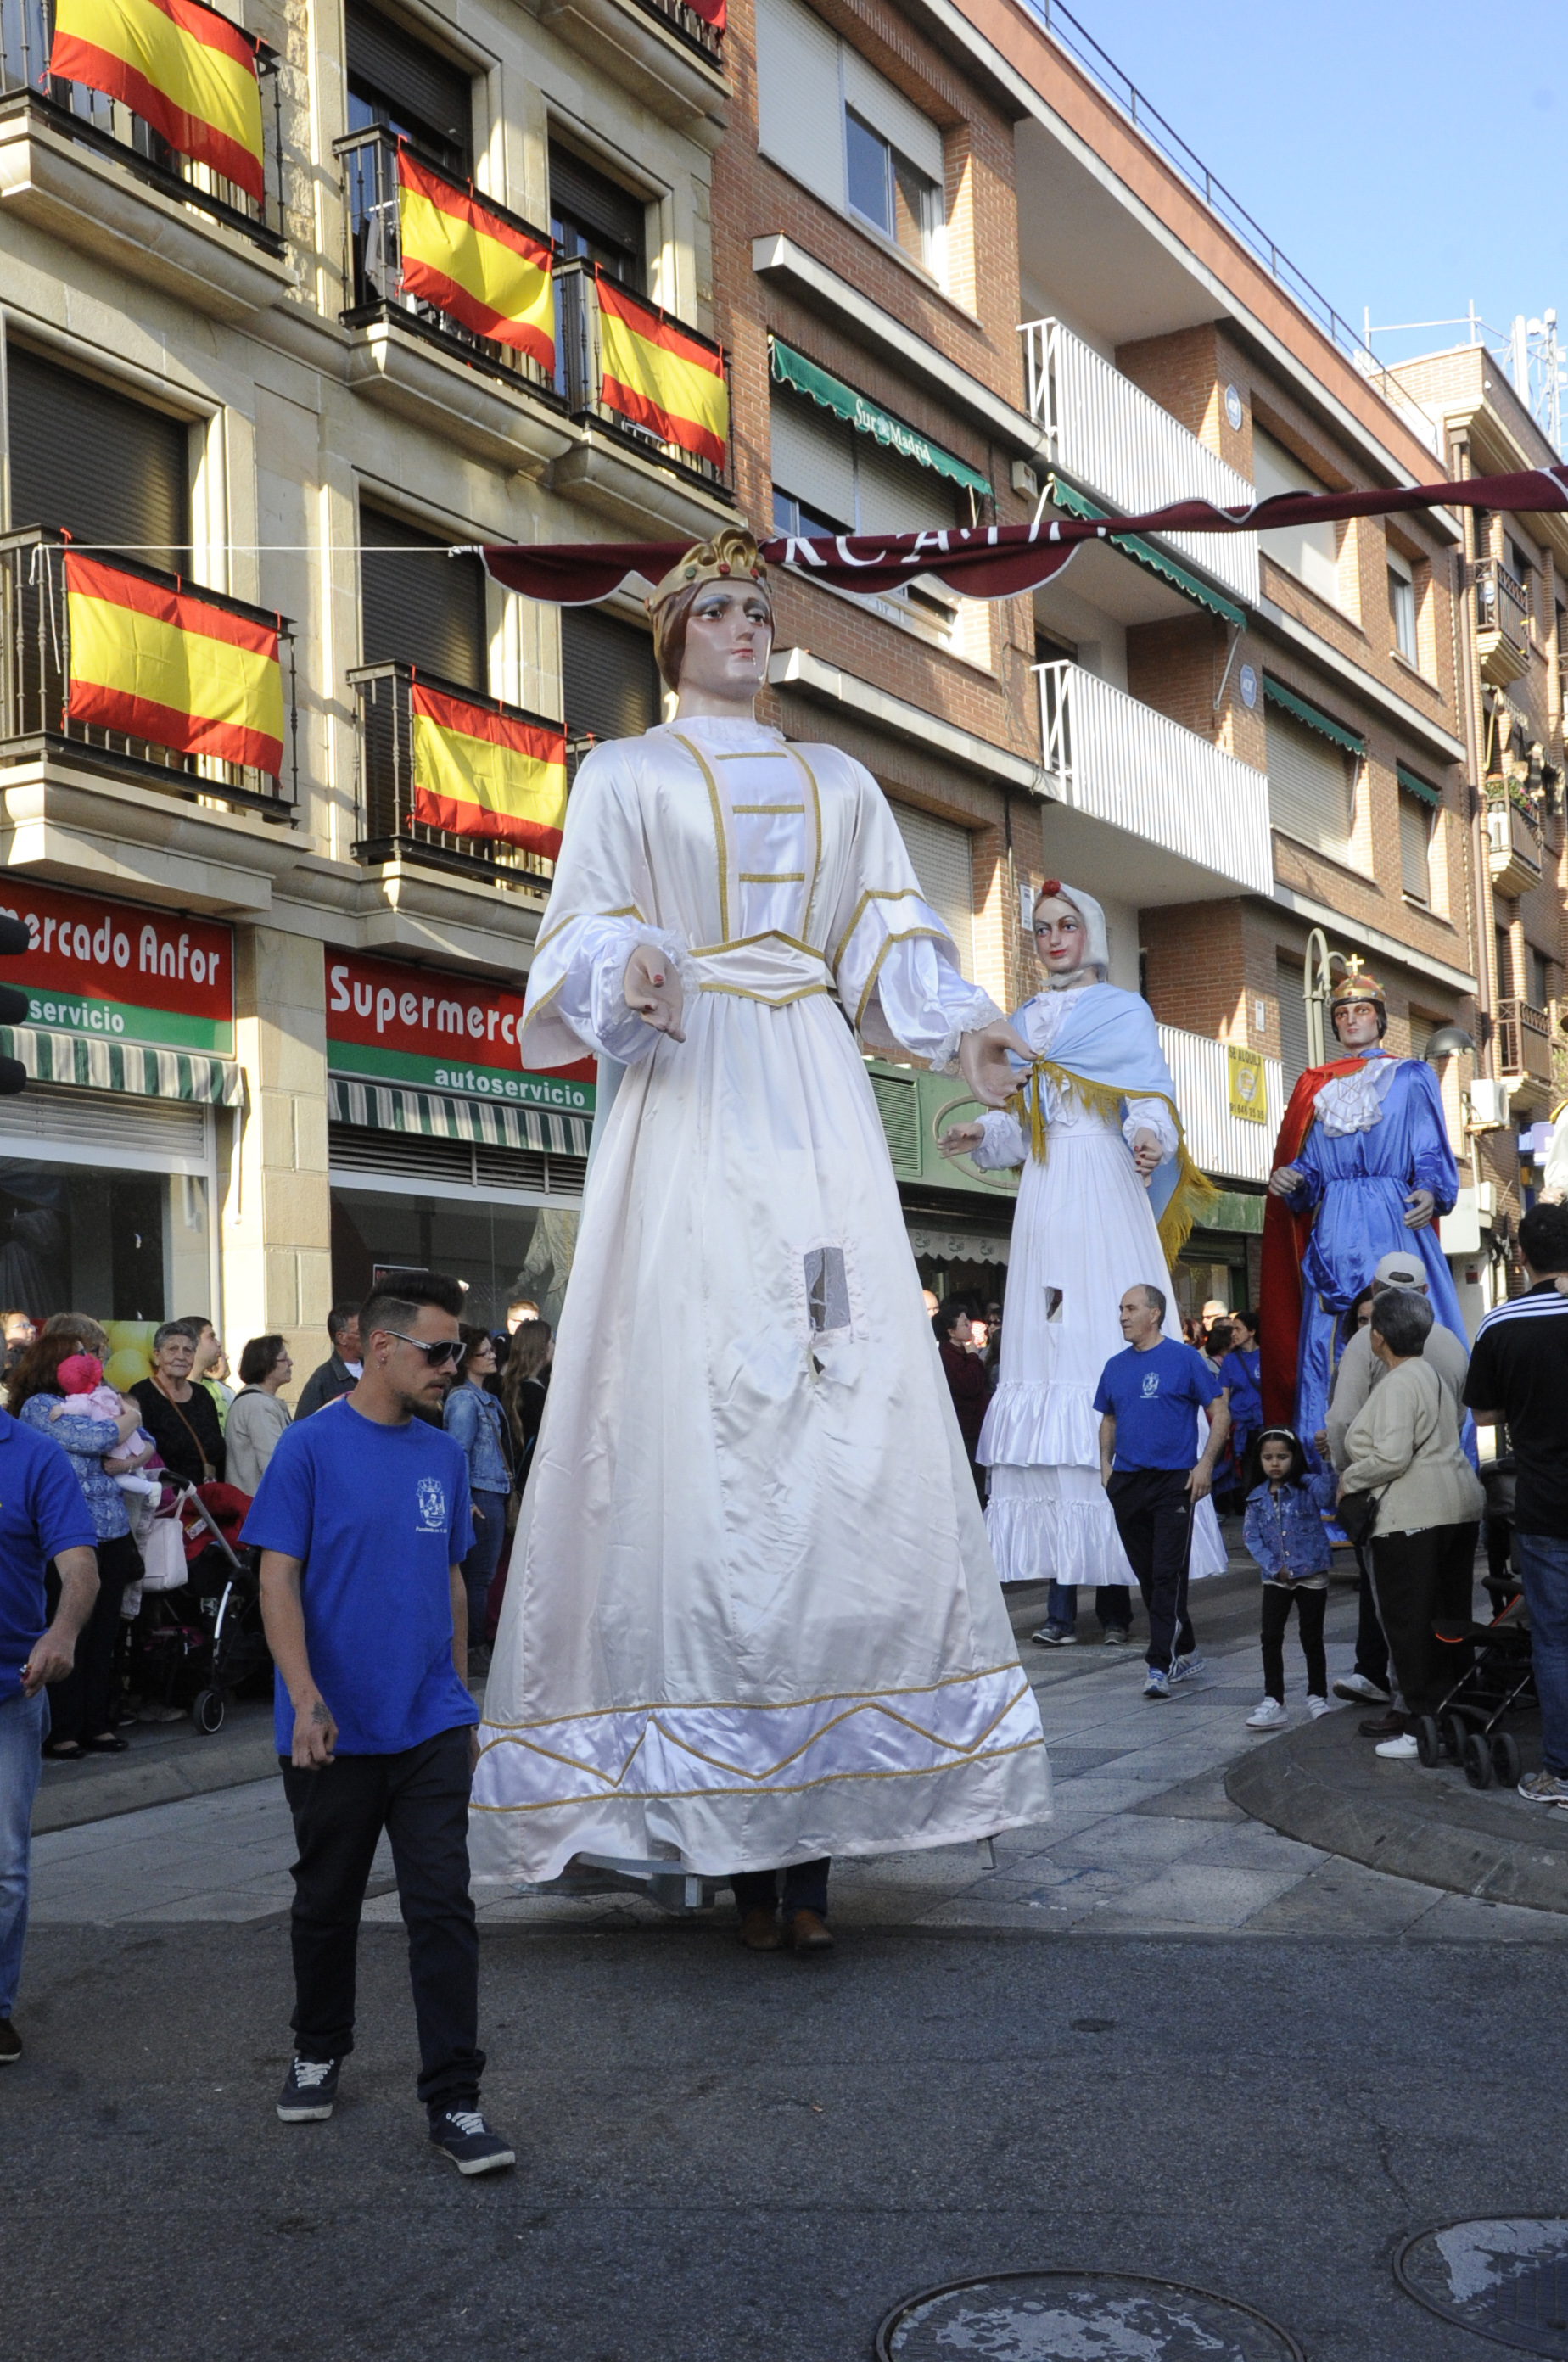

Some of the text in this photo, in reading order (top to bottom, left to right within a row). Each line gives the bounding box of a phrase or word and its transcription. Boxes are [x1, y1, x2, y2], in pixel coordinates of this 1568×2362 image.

[854, 399, 932, 463] Sur Madrid
[139, 925, 220, 985] Anfor
[1238, 1049, 1262, 1066] ALQUILA
[434, 1068, 585, 1107] autoservicio
